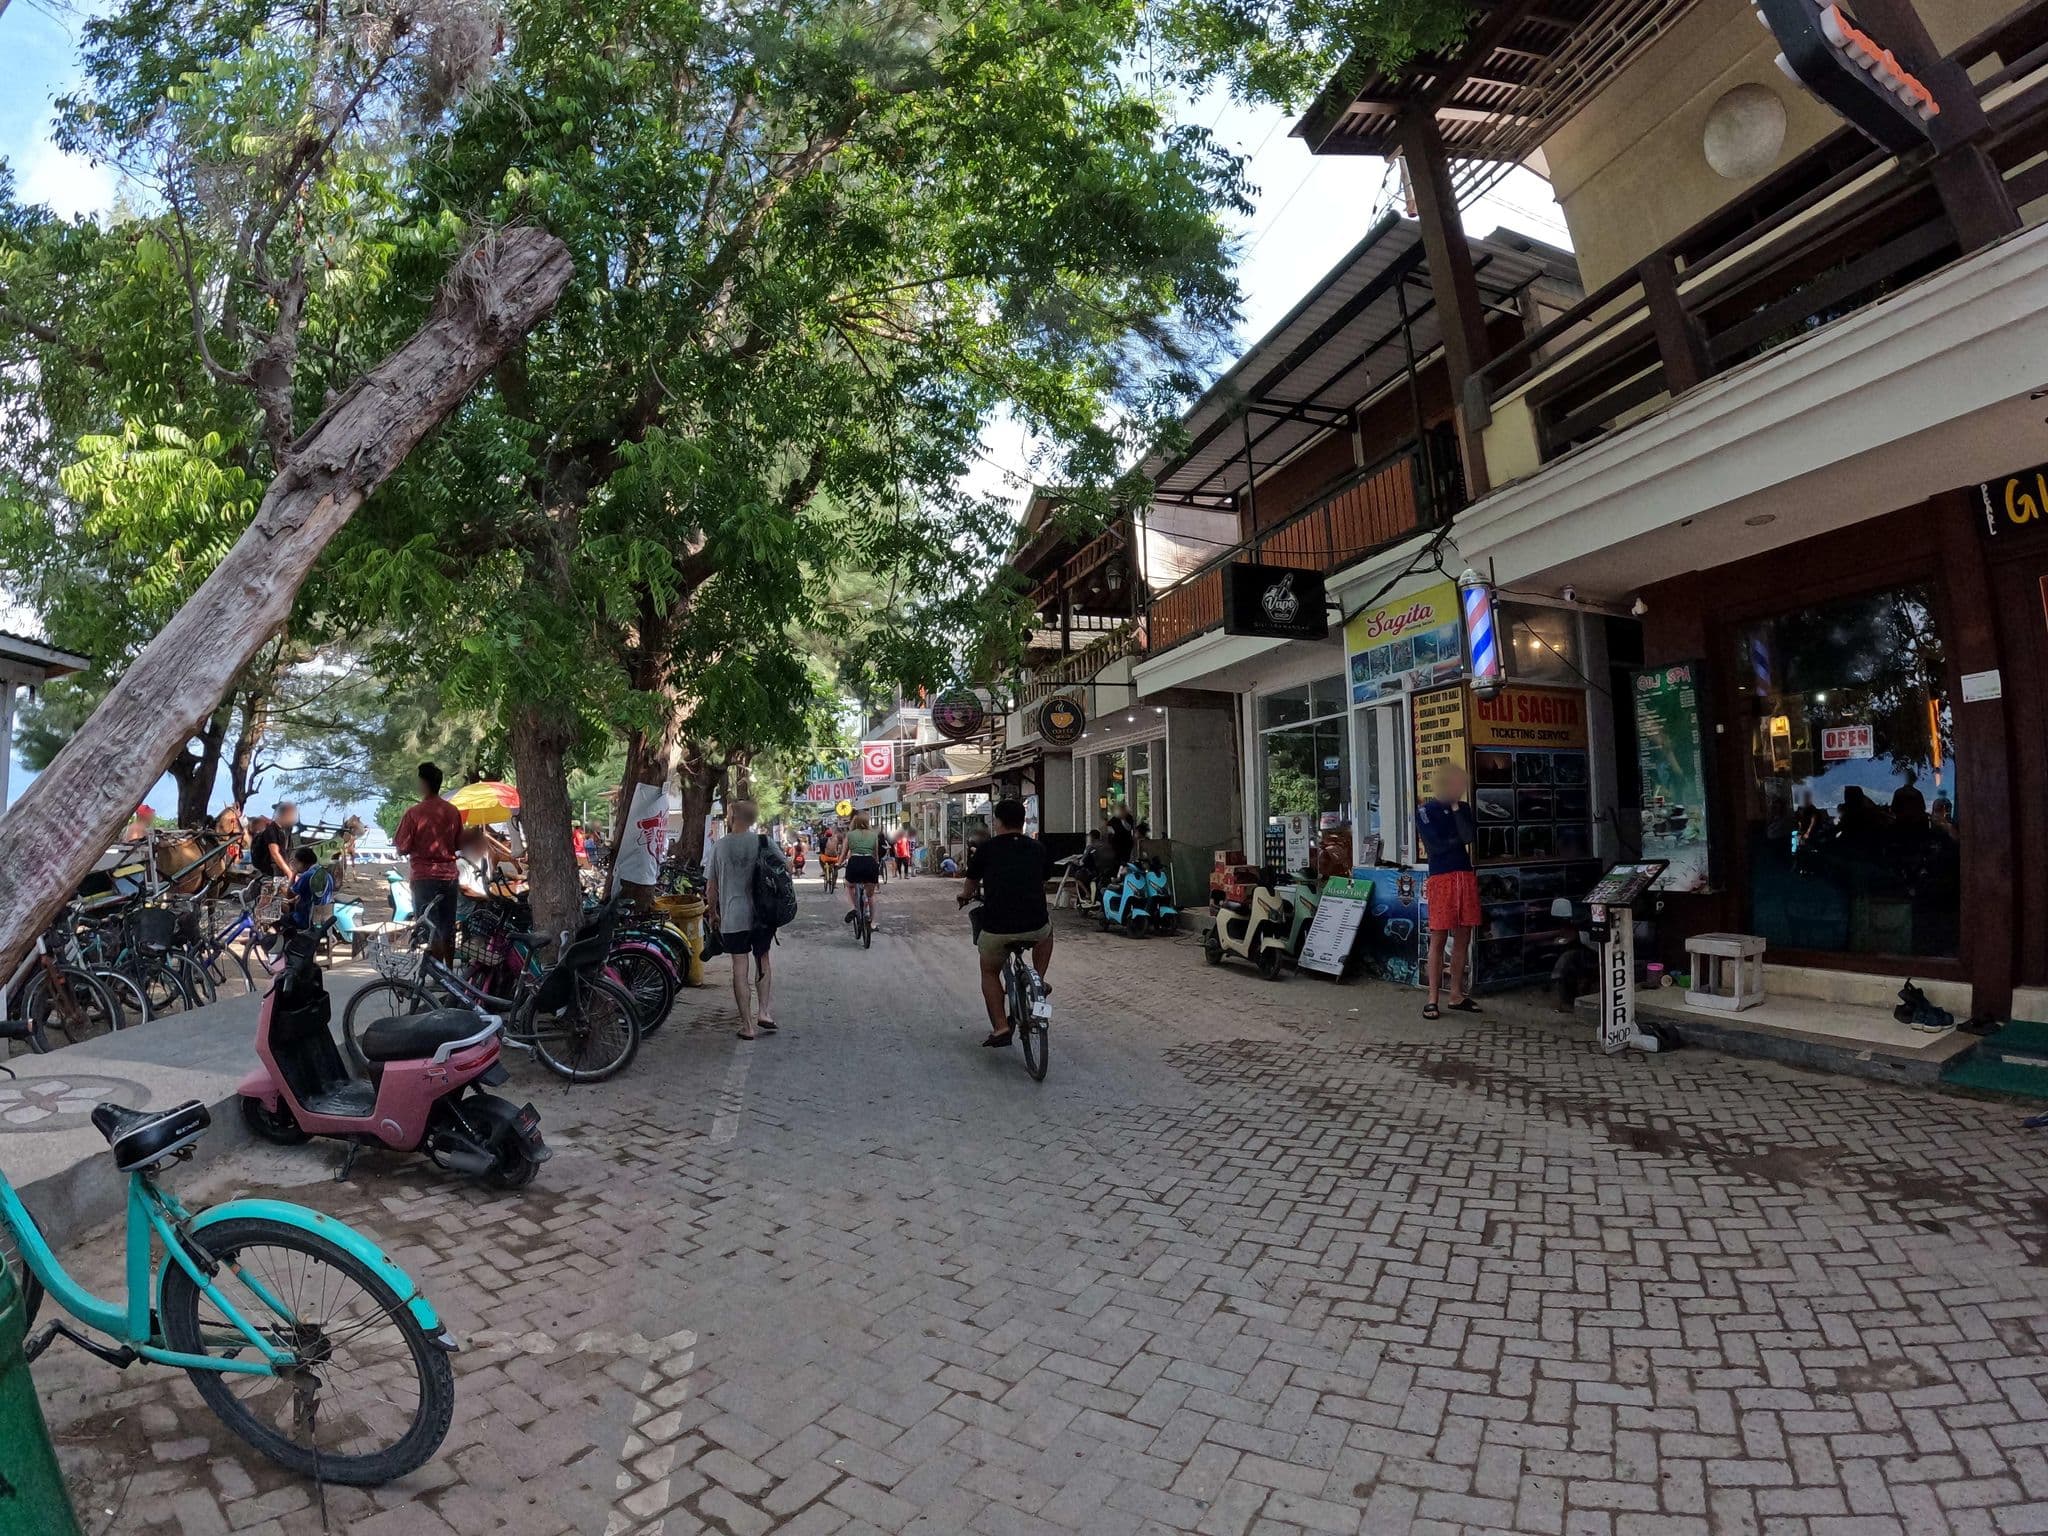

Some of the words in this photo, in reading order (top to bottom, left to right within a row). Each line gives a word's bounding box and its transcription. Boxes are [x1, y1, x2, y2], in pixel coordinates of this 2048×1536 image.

[1266, 597, 1297, 611] Vape
[1367, 603, 1434, 638] Sagita
[1517, 694, 1579, 725] SAGITA
[1491, 727, 1535, 740] TICKETING
[1537, 729, 1569, 740] SERVICE
[1826, 730, 1868, 749] OPEN
[808, 783, 830, 800] NEW
[834, 781, 856, 799] GYM
[1611, 912, 1627, 1026] BARBER
[1607, 1028, 1631, 1046] SHOP
